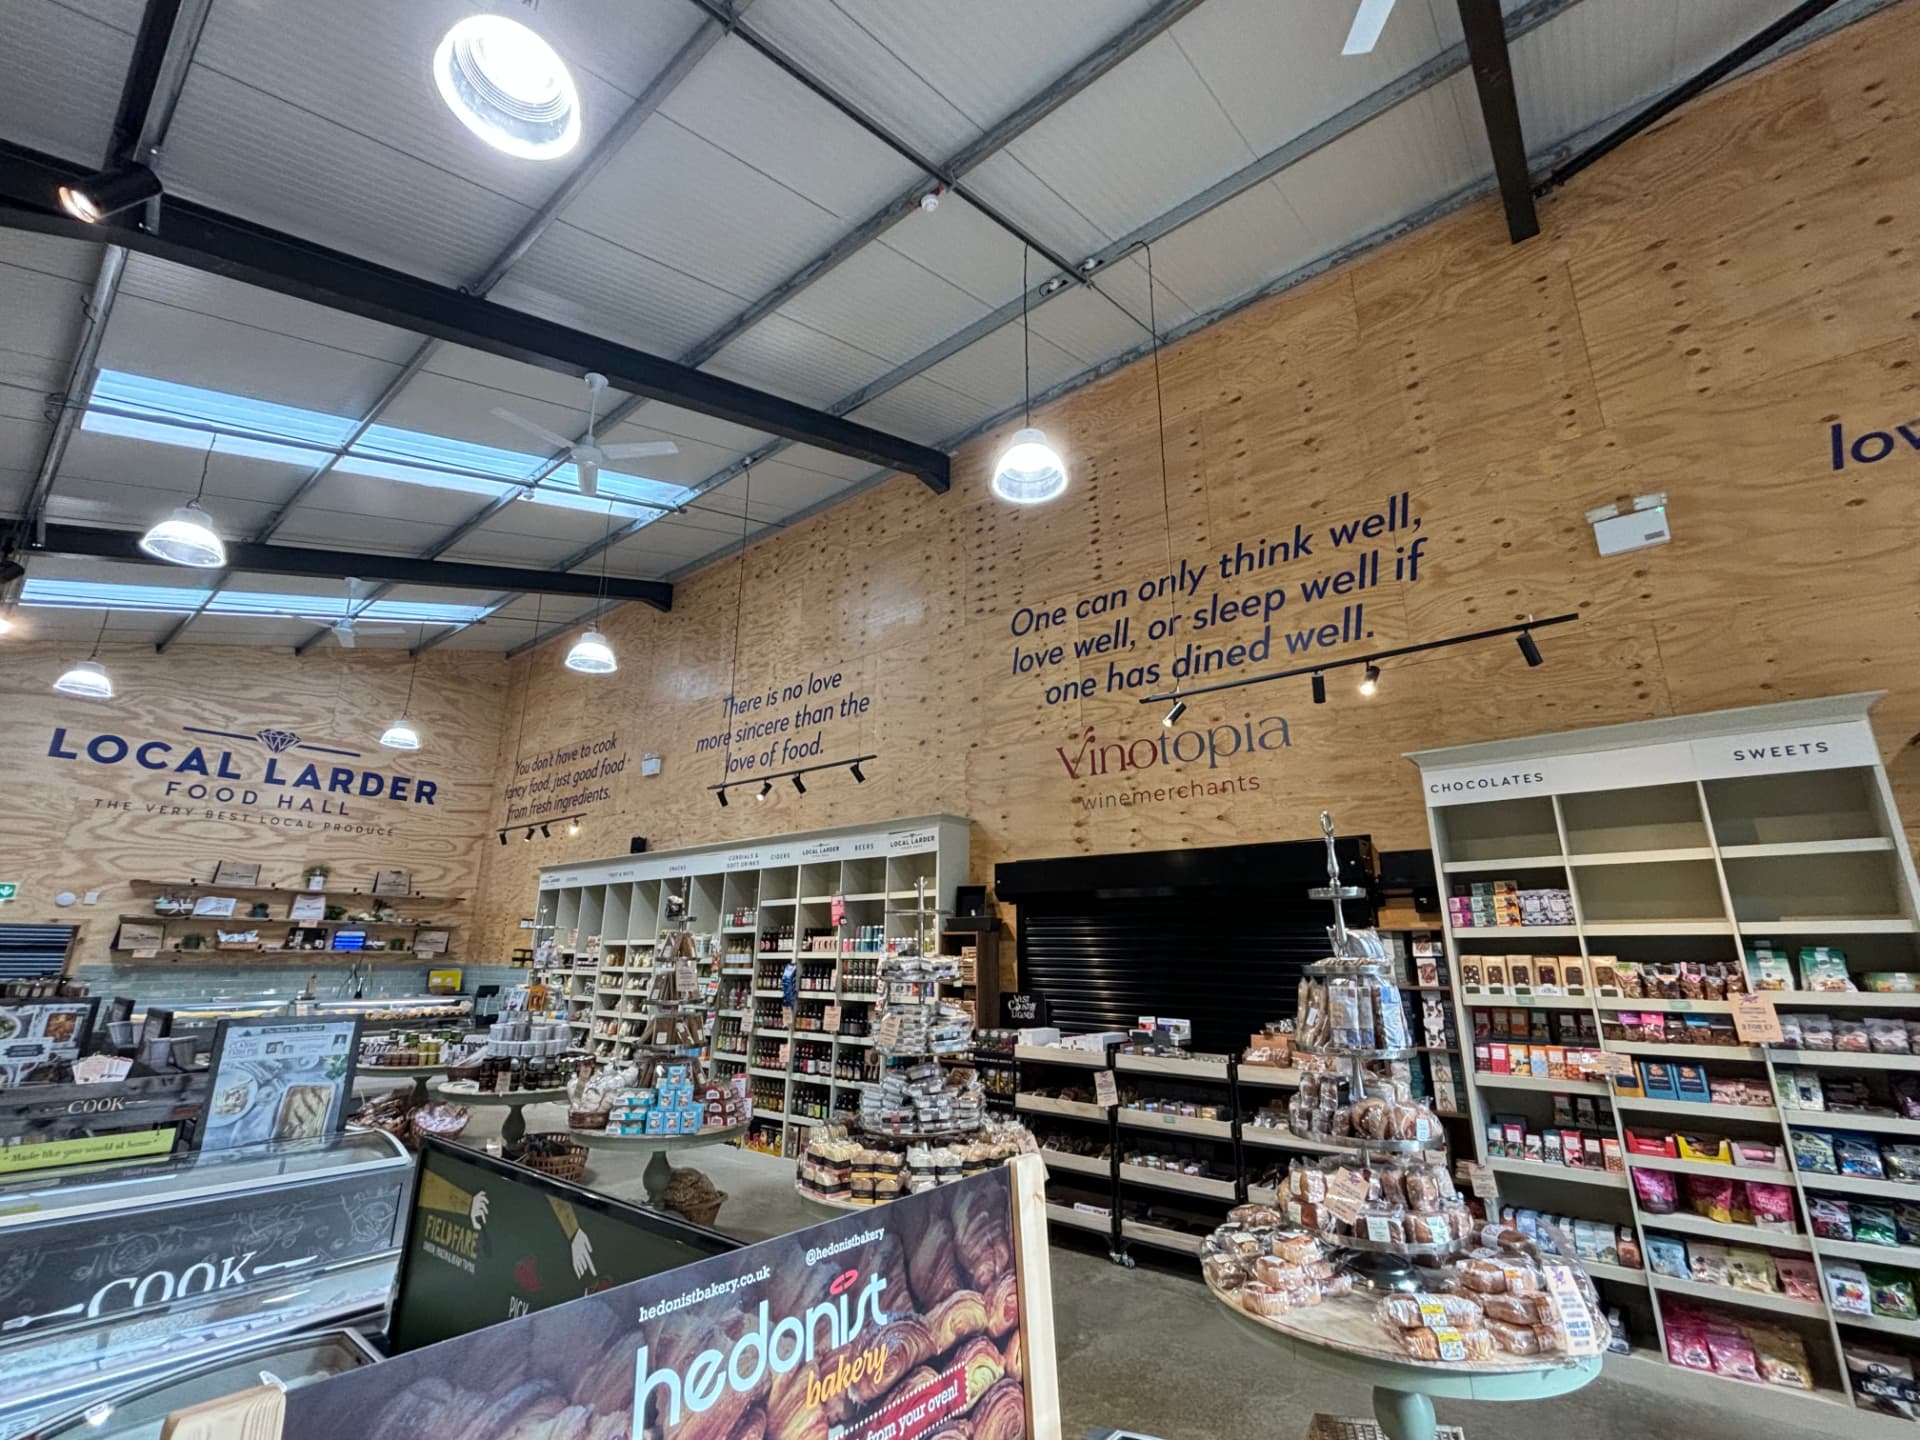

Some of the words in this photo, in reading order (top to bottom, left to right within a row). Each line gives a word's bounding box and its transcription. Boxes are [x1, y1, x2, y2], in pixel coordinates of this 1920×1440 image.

[1011, 608, 1066, 636] One
[1076, 586, 1128, 620] can
[1138, 559, 1209, 603] only
[1219, 524, 1314, 579] think
[1329, 491, 1422, 548] well,
[1012, 643, 1064, 676] love
[1073, 617, 1137, 659] well,
[1148, 612, 1182, 642] or
[1192, 594, 1287, 631] sleep
[1300, 549, 1378, 602] well
[1396, 536, 1428, 582] if
[1045, 677, 1097, 705] one
[1107, 662, 1161, 693] has
[1171, 624, 1272, 679] dined
[1285, 603, 1375, 655] well.
[722, 694, 762, 719] There
[766, 688, 778, 707] is
[783, 684, 803, 703] no
[808, 672, 843, 695] love
[696, 732, 731, 753] more
[735, 716, 790, 744] sincere
[795, 704, 834, 729] than
[840, 692, 870, 718] the
[1056, 712, 1292, 780] Vinotopia
[48, 727, 241, 780] LOCAL
[264, 758, 438, 806] LARDER
[516, 760, 530, 777] You
[556, 748, 578, 766] have
[581, 744, 591, 759] to
[593, 731, 617, 754] cook
[727, 752, 756, 773] love
[760, 740, 779, 767] of
[782, 731, 824, 764] food.
[1734, 740, 1829, 762] SWEETS
[165, 781, 258, 806] FOOD
[278, 794, 350, 817] HALL
[504, 783, 529, 801] fancy
[551, 771, 572, 793] just
[573, 759, 600, 788] good
[600, 752, 626, 778] food
[1430, 772, 1545, 794] CHOCOLATES
[95, 798, 133, 812] THE
[146, 803, 194, 818] VERY
[205, 809, 250, 823] BEST
[260, 815, 313, 830] LOCAL
[323, 821, 393, 838] PRODUCE
[509, 803, 530, 820] from
[529, 795, 552, 817] fresh
[554, 786, 610, 813] ingredients.
[854, 843, 875, 853] BEERS
[889, 840, 909, 848] LOCAL
[910, 835, 935, 845] LARDER
[67, 1096, 127, 1115] COOK
[424, 1215, 479, 1259] FIELDFARE
[806, 1227, 885, 1266] @hedonistbakery
[87, 1251, 257, 1315] COOK
[639, 1264, 771, 1323] hedonistbakery.co.uk
[632, 1272, 888, 1440] hedonist
[806, 1343, 888, 1410] bakery
[898, 1402, 926, 1436] your
[928, 1379, 959, 1413] oven!
